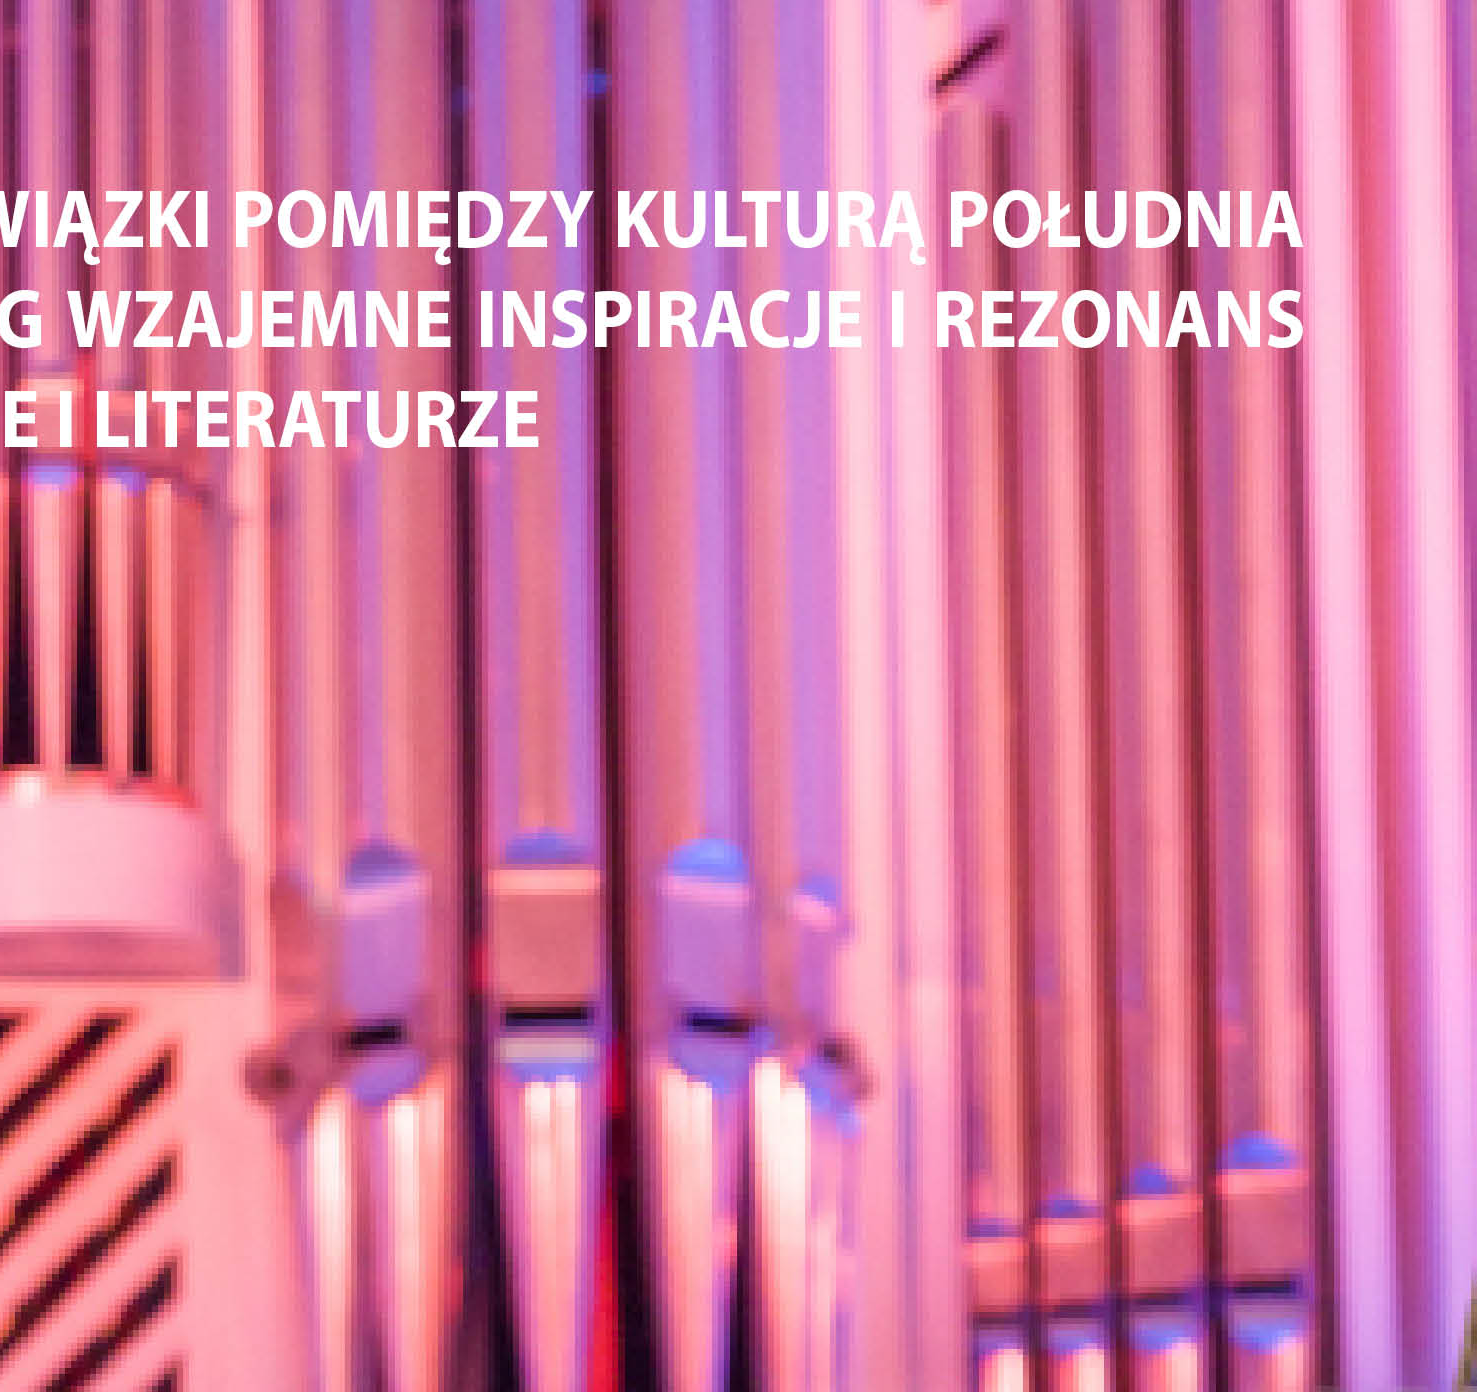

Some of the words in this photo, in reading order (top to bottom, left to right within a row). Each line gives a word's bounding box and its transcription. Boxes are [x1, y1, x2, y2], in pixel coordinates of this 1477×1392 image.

[235, 190, 593, 266] POMIĘDZY
[617, 190, 926, 266] KULTURĄ
[950, 190, 1303, 249] POŁUDNIA
[67, 290, 451, 349] WZAJEMNE
[480, 289, 862, 349] INSPIRACJE
[891, 290, 904, 348] I
[936, 289, 1303, 349] REZONANS
[59, 390, 72, 448] I
[96, 390, 539, 449] LITERATURZE
